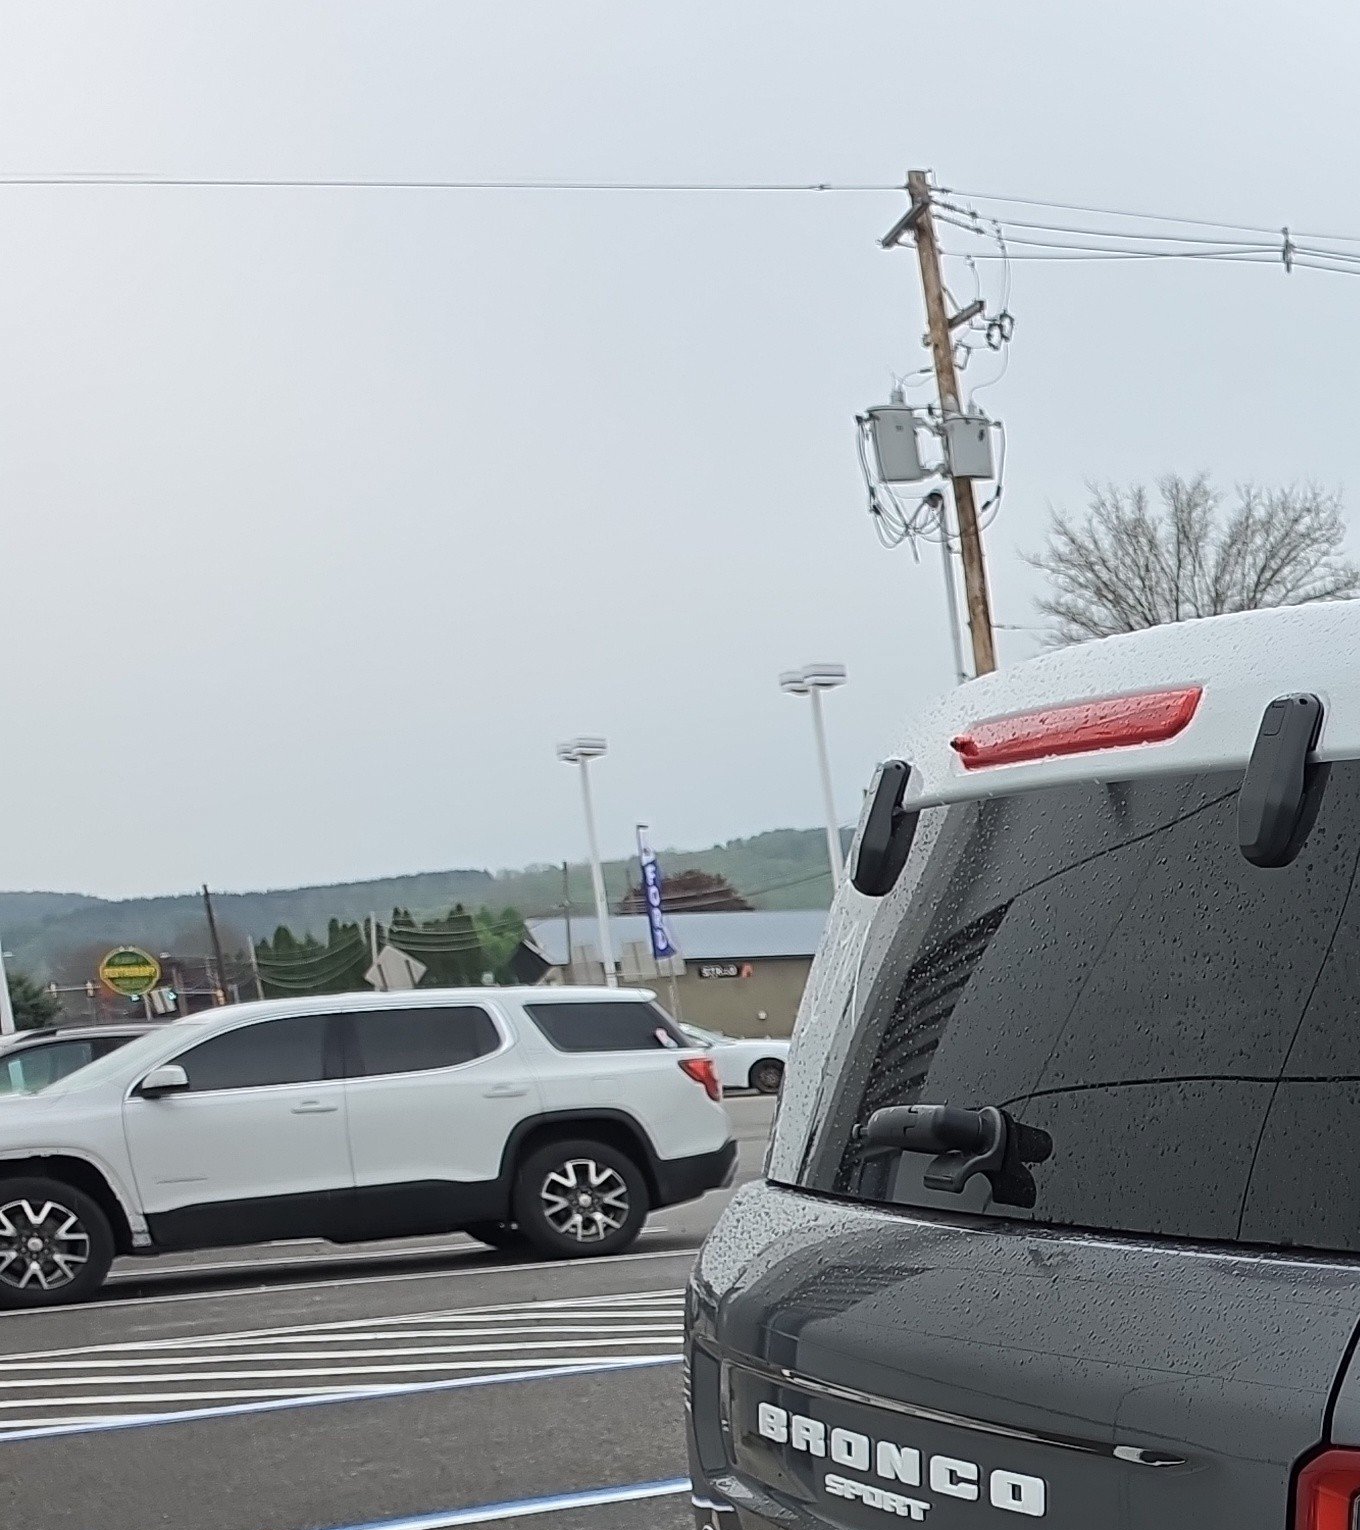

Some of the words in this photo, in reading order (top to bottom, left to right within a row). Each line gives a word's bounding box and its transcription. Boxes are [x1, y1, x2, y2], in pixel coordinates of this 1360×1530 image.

[644, 863, 668, 950] FORD
[758, 1401, 1046, 1518] BRONCO
[824, 1473, 931, 1522] SPORT
